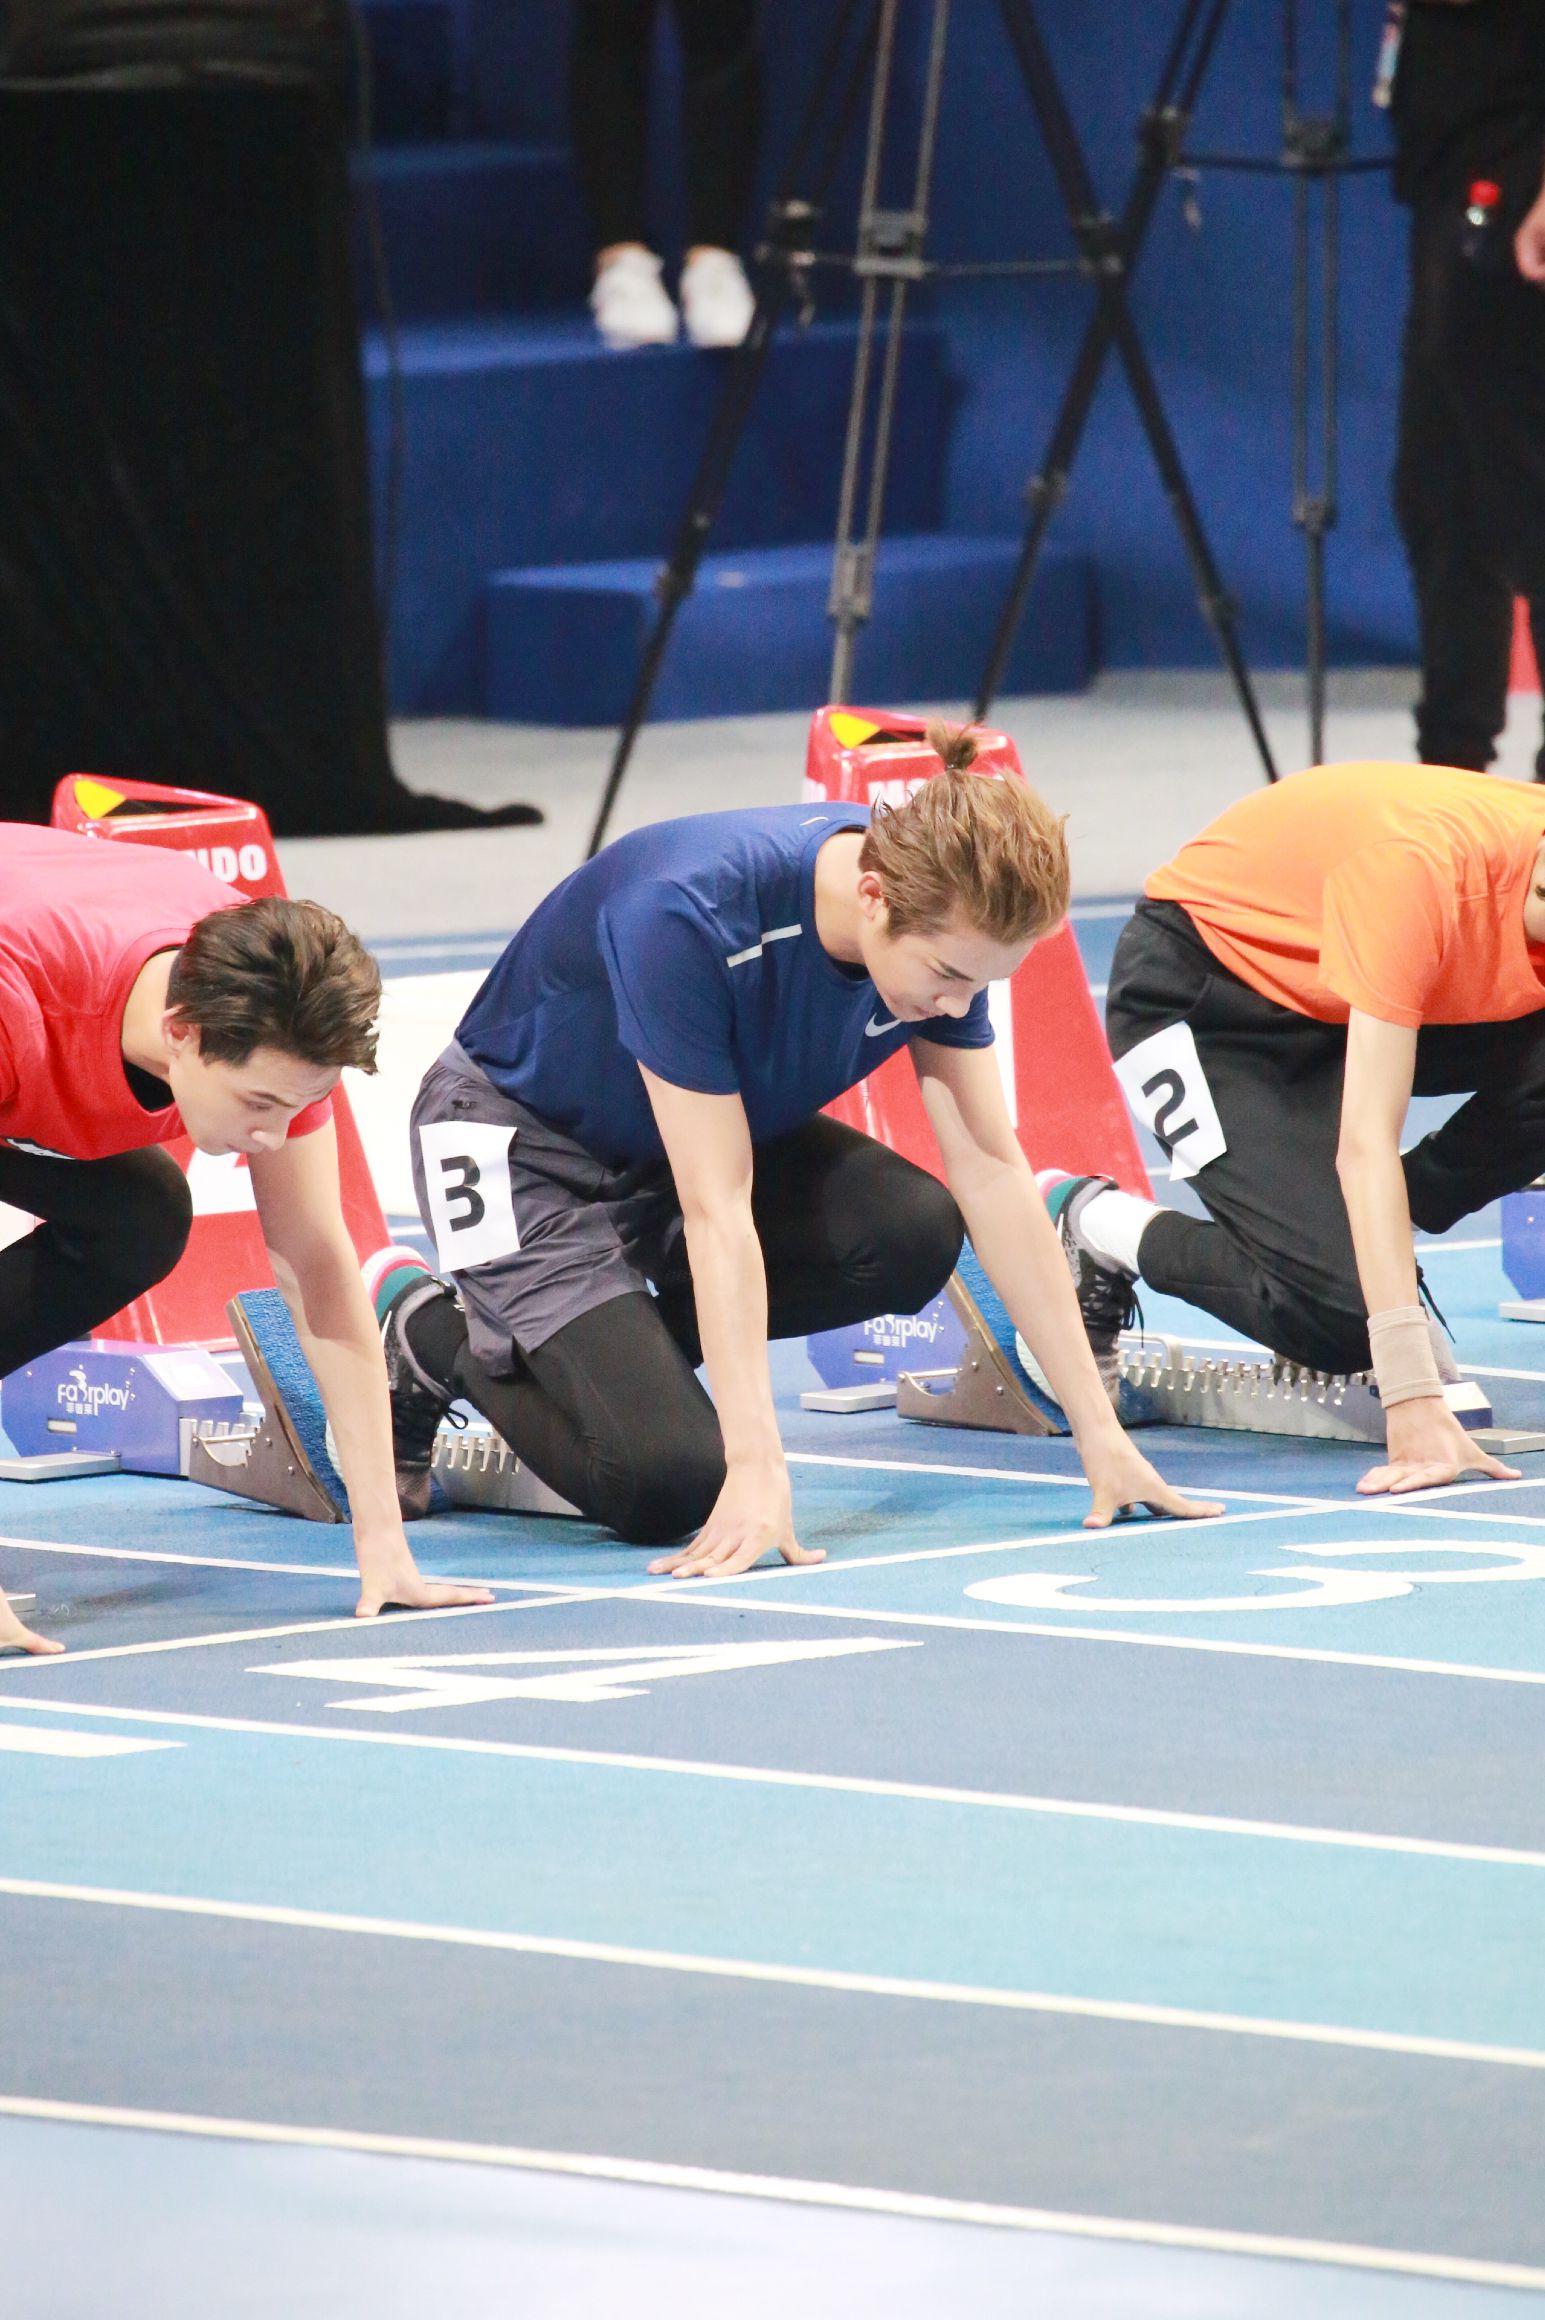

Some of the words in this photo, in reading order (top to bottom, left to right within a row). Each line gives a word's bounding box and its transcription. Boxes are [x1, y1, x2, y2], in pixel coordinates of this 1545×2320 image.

[1140, 1068, 1200, 1147] 2
[440, 1155, 485, 1233] 3
[244, 1636, 925, 1712] 4
